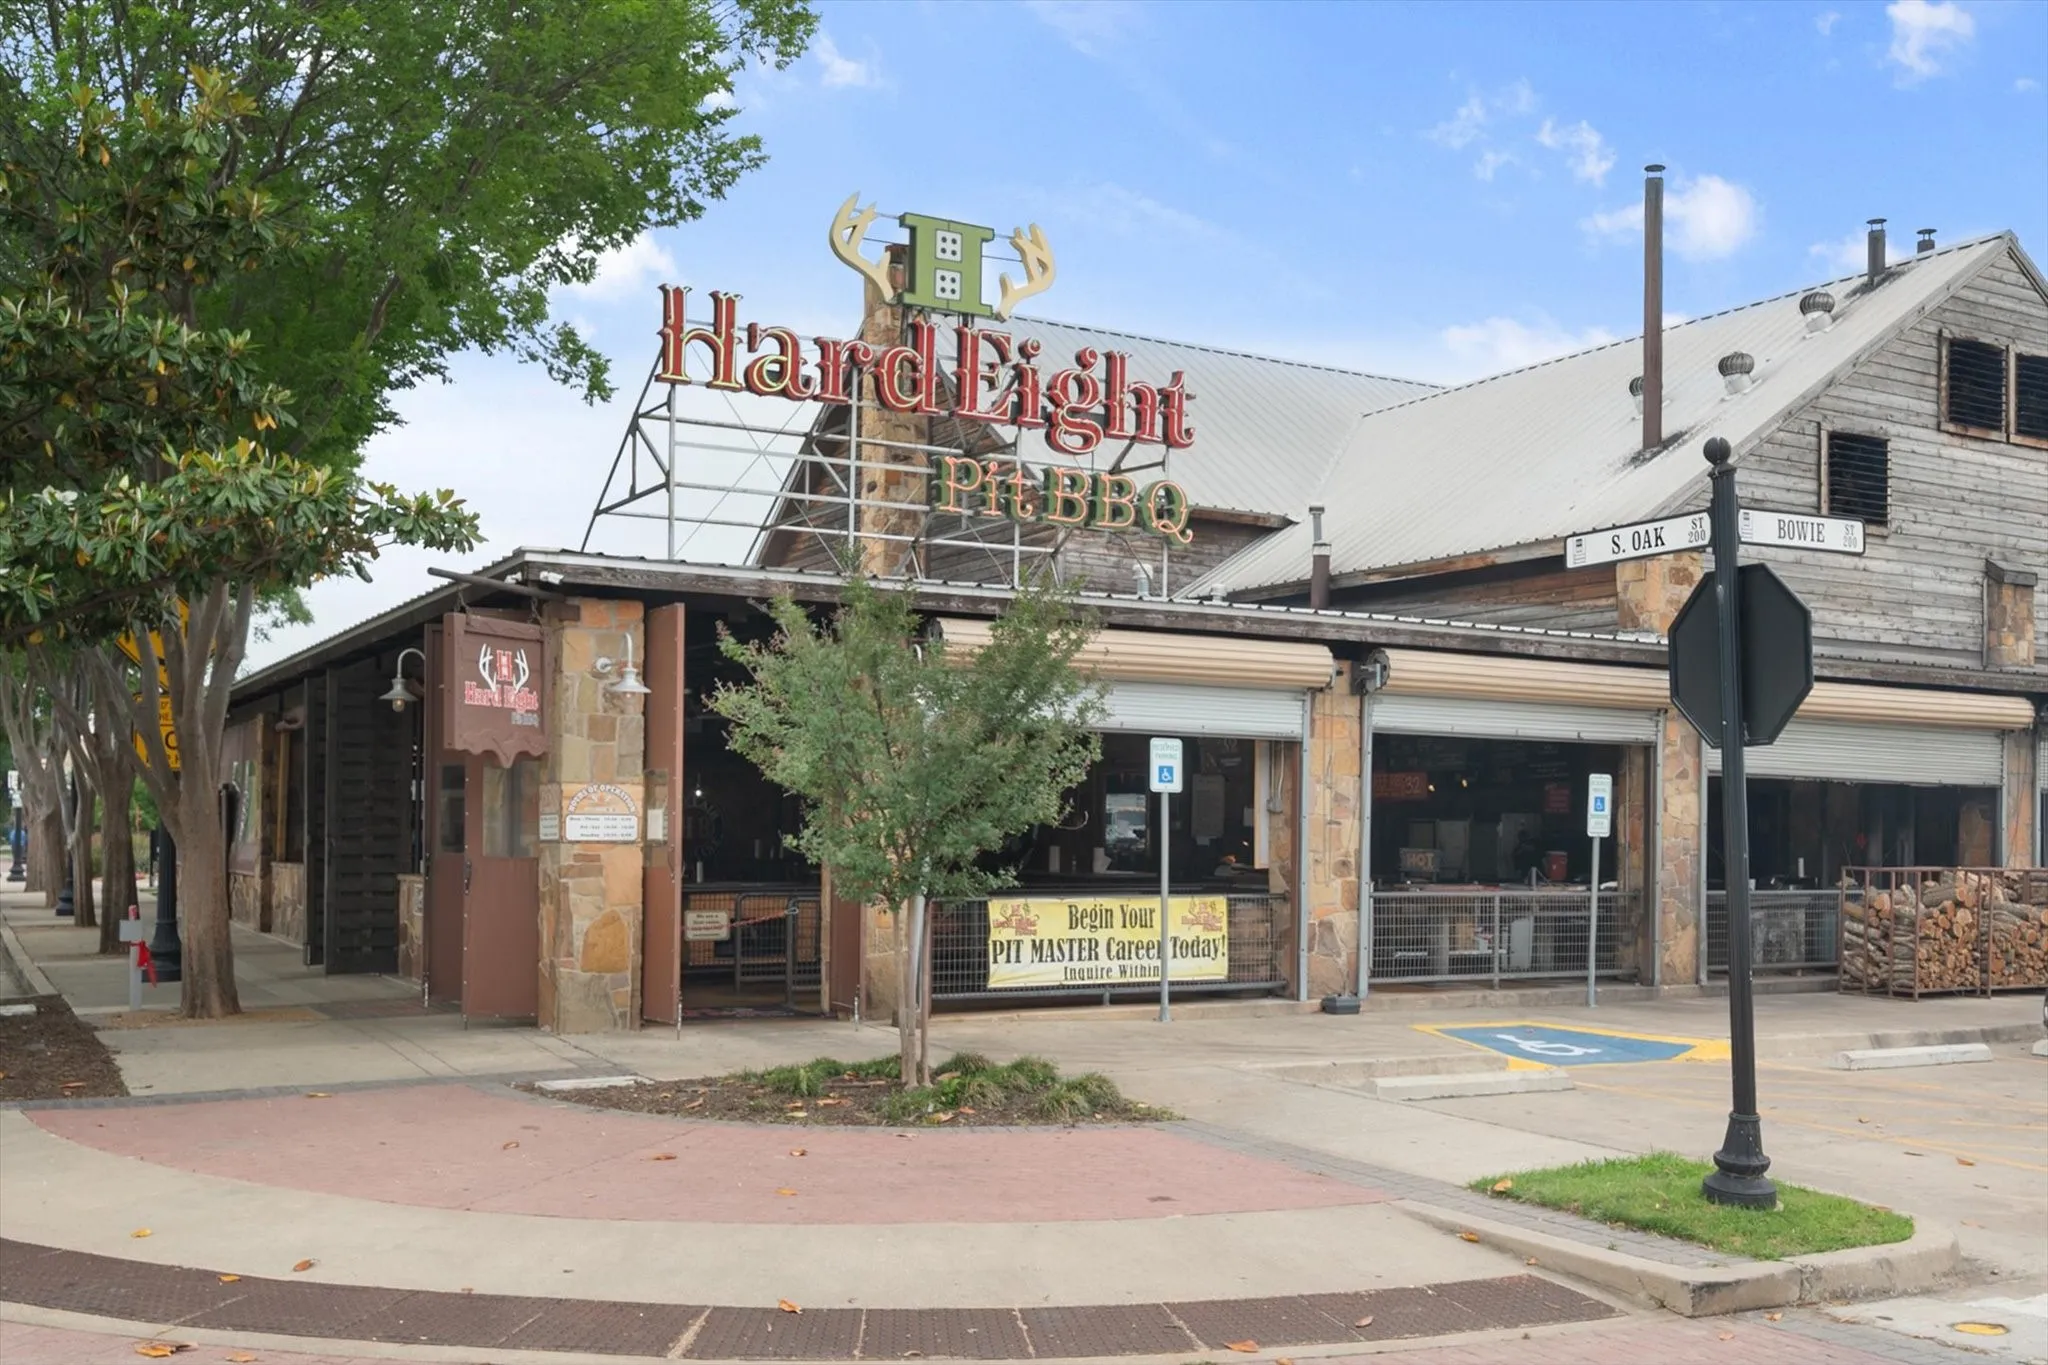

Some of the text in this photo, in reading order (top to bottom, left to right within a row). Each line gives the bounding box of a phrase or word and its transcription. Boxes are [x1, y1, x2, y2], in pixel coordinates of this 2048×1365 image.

[1691, 516, 1705, 530] ST
[1777, 518, 1826, 543] BOWIE
[1844, 522, 1856, 536] ST
[1611, 526, 1666, 555] S. OAK
[1688, 529, 1707, 543] 200
[1843, 535, 1858, 549] 200
[465, 680, 502, 707] Hard
[1407, 852, 1435, 870] HOT
[1068, 903, 1114, 933] Begin
[1120, 902, 1156, 930] Your
[991, 939, 1024, 965] PIT
[1031, 937, 1100, 964] MASTER
[1170, 934, 1226, 961] Today!
[1064, 963, 1161, 982] Inquire Within
